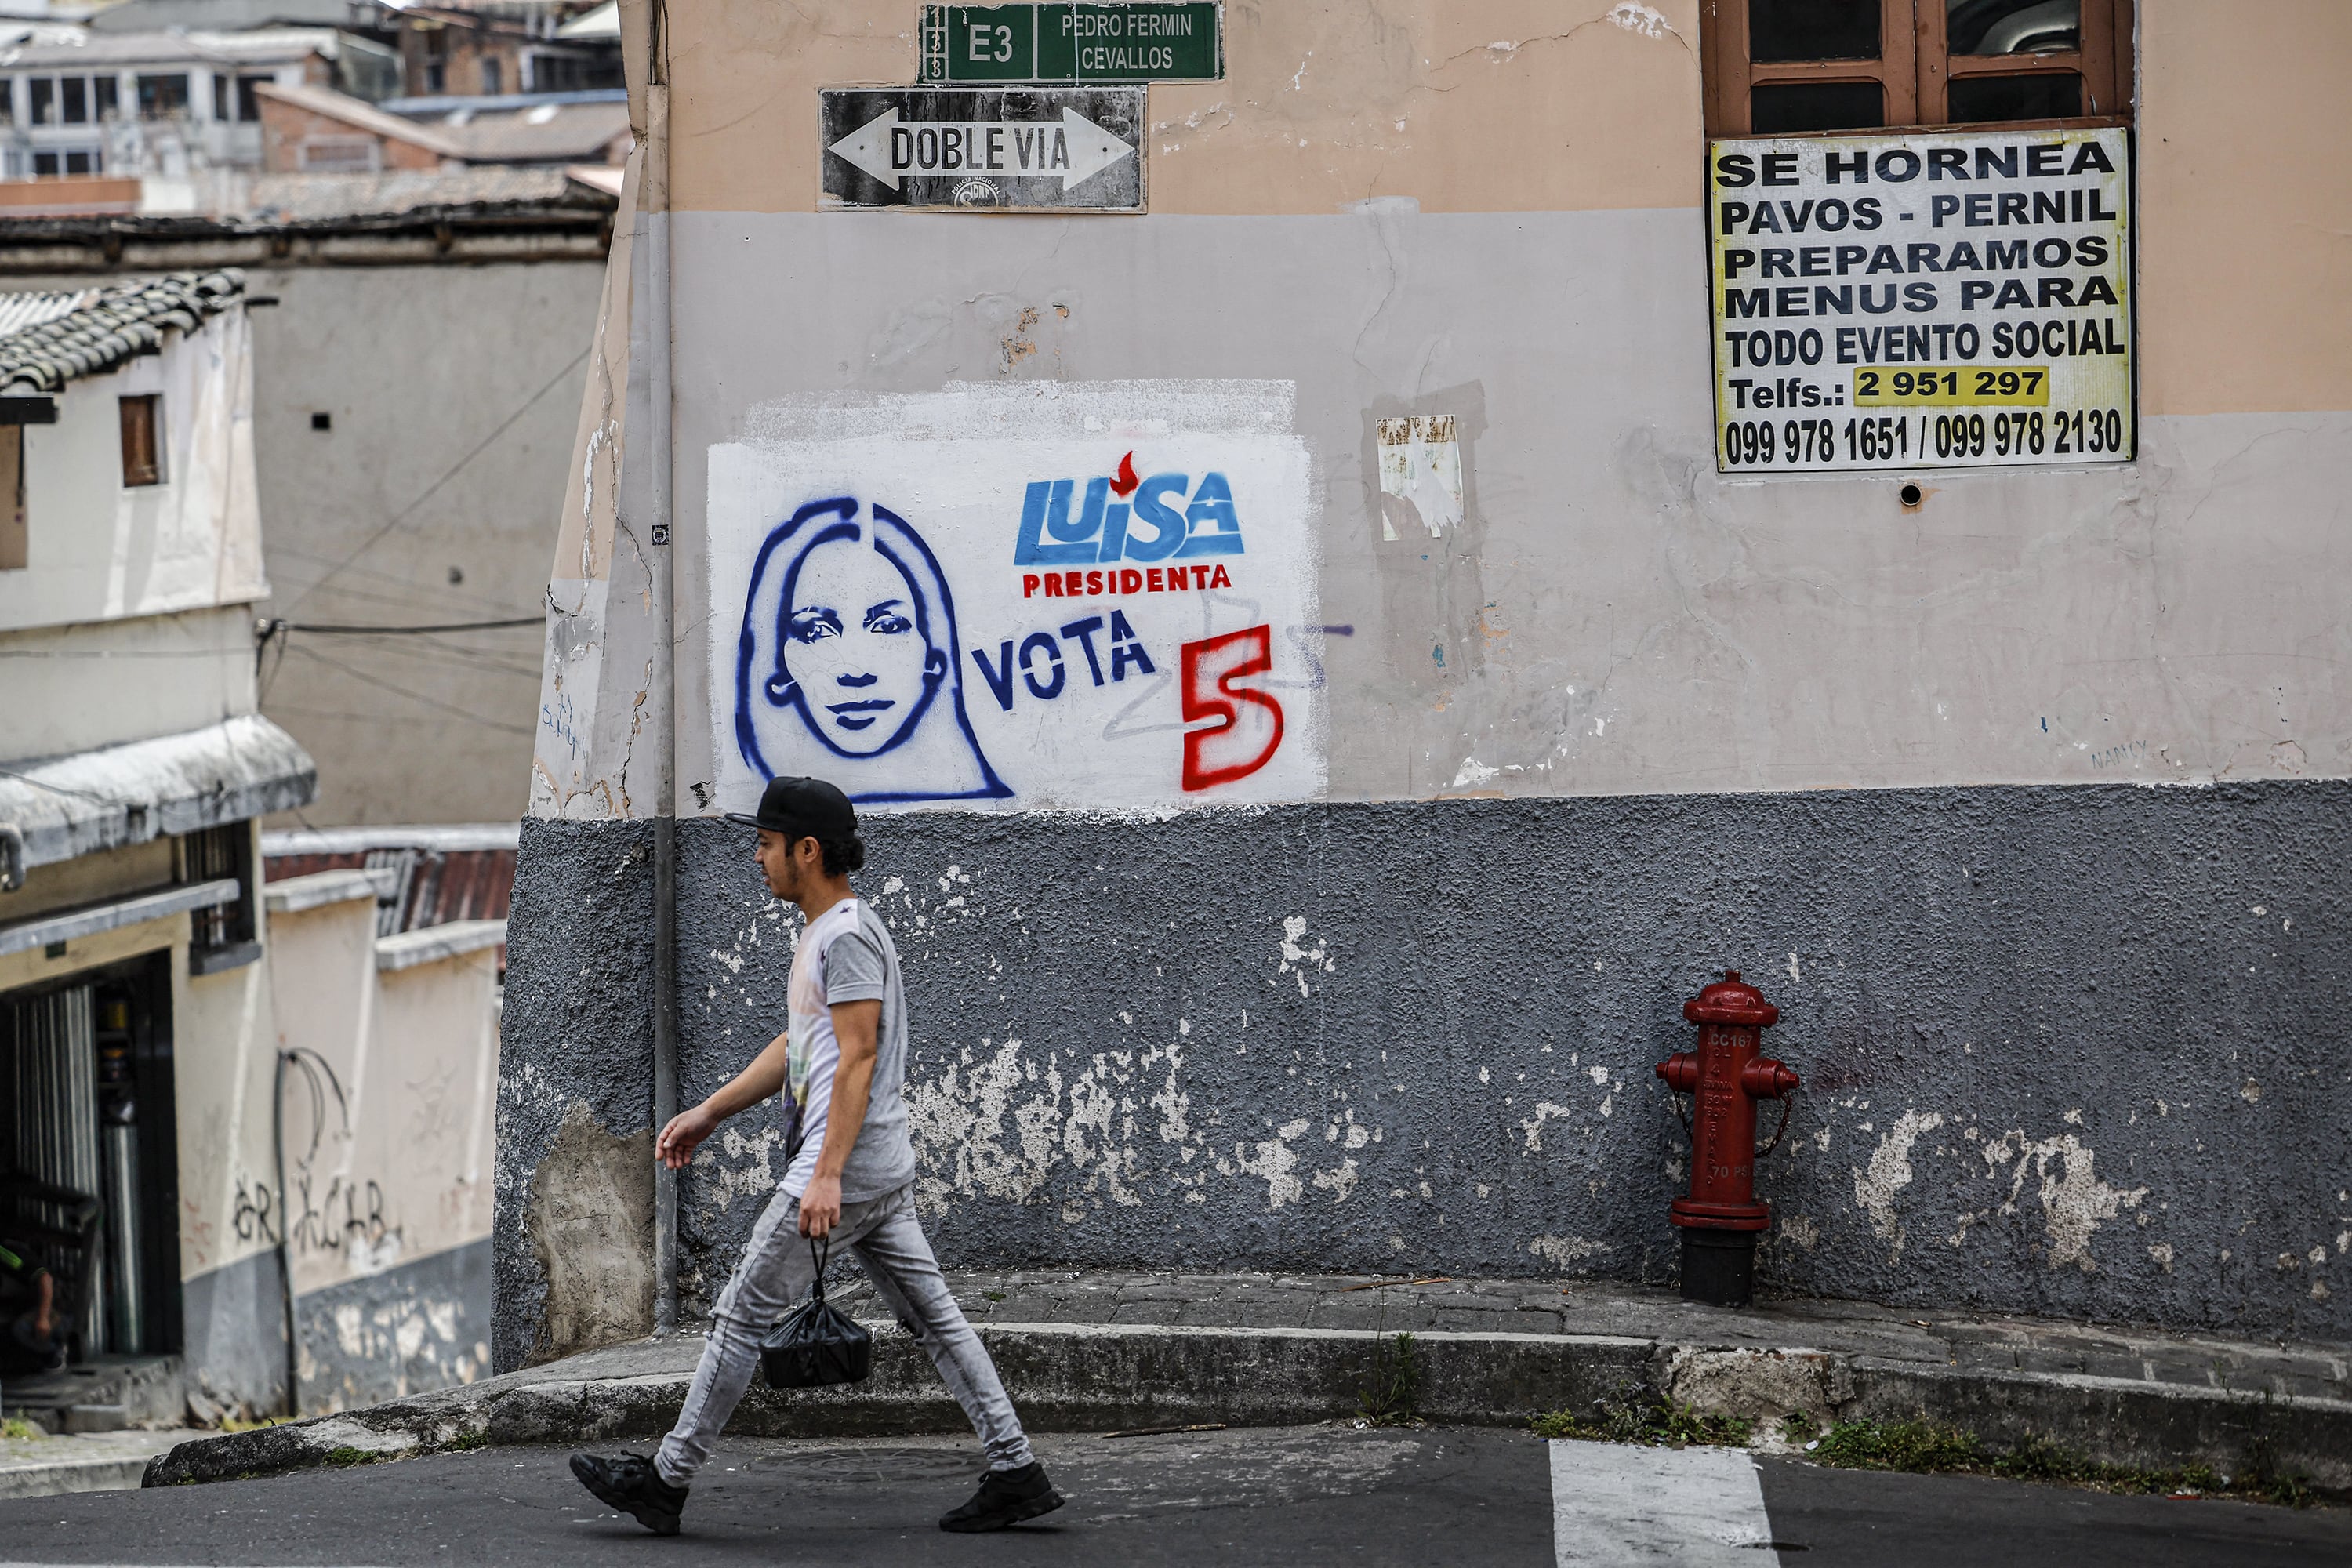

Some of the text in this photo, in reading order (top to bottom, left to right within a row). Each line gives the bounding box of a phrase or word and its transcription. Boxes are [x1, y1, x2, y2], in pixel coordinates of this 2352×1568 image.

[970, 25, 1012, 62] E3
[1063, 14, 1191, 36] PEDRO FERMIN
[1083, 47, 1172, 70] CEVALLOS
[891, 128, 1070, 169] DOBLE VIA
[1716, 142, 2115, 187] SE HORNEA
[951, 176, 1001, 195] POLICIA NACIONAL
[1722, 198, 1882, 234] PAVOS
[1932, 189, 2116, 227] PERNIL
[1725, 236, 2108, 279] PREPARAMOS
[1725, 276, 2118, 318] MENUS PARA
[1725, 318, 2125, 367] TODO EVENTO SOCIAL
[1729, 372, 2043, 409] Telfs.: 2 951 297
[1726, 409, 2122, 464] 099 978 1651 / 099 978 2130
[1023, 564, 1232, 598] PRESIDENTA
[971, 609, 1156, 711] VOTA
[1181, 624, 1284, 792] 5
[1712, 1167, 1729, 1178] 70
